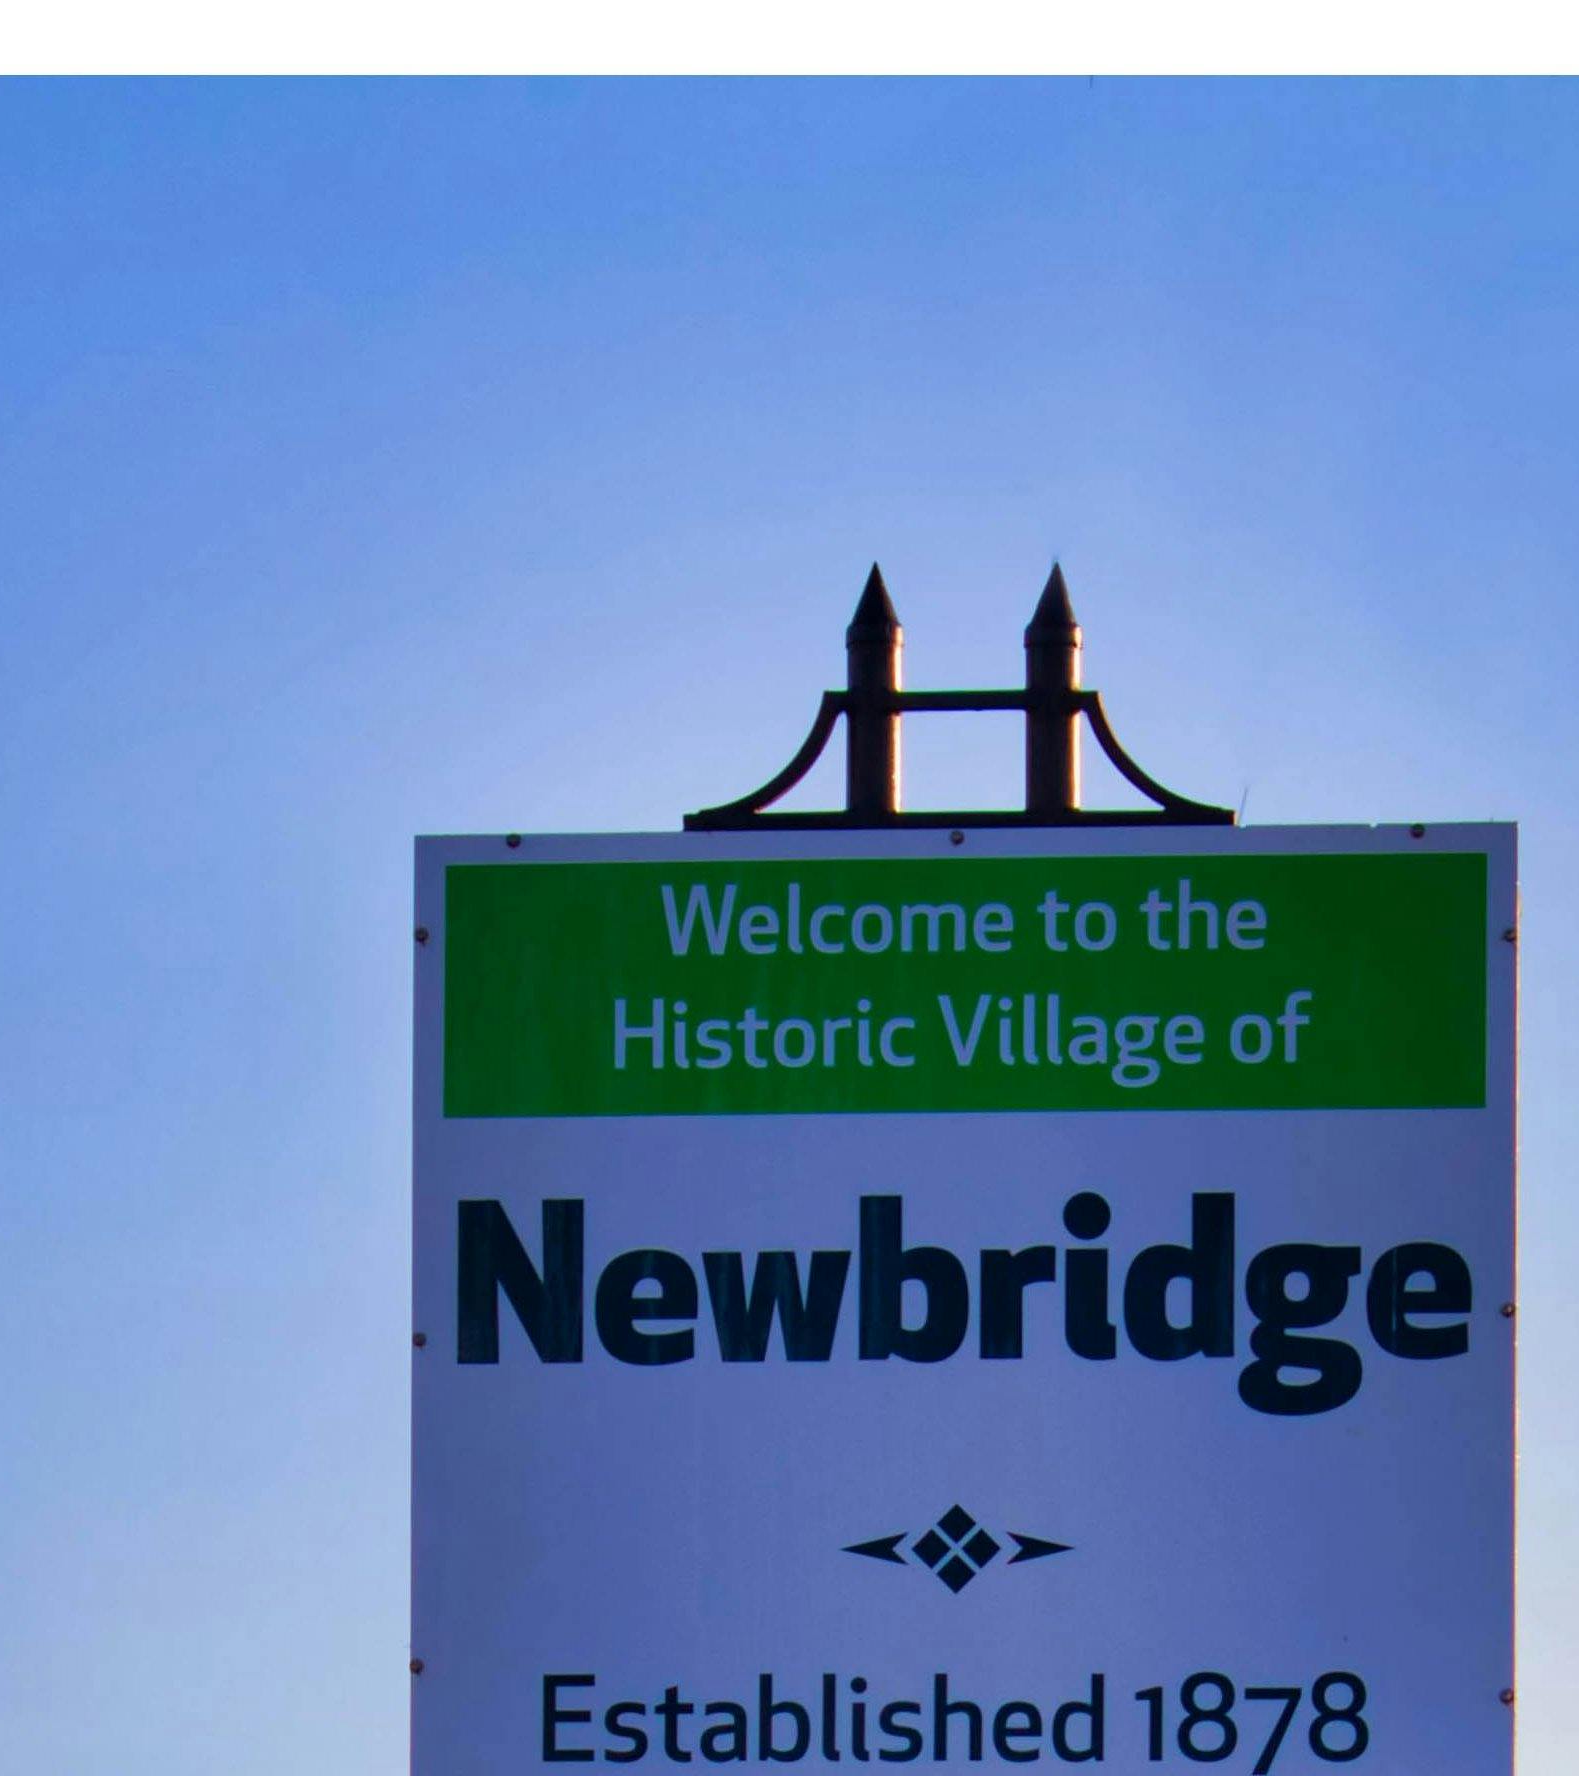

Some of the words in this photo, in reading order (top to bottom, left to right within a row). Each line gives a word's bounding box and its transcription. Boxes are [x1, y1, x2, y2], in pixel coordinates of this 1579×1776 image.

[662, 883, 1013, 955] Welcome
[1042, 895, 1116, 951] to
[1140, 879, 1267, 950] the
[614, 998, 915, 1069] Historic
[938, 994, 1204, 1088] Village
[1231, 991, 1311, 1064] of
[456, 1191, 1473, 1416] Newbridge
[542, 1673, 1105, 1763] Established
[1135, 1671, 1369, 1776] 1878
